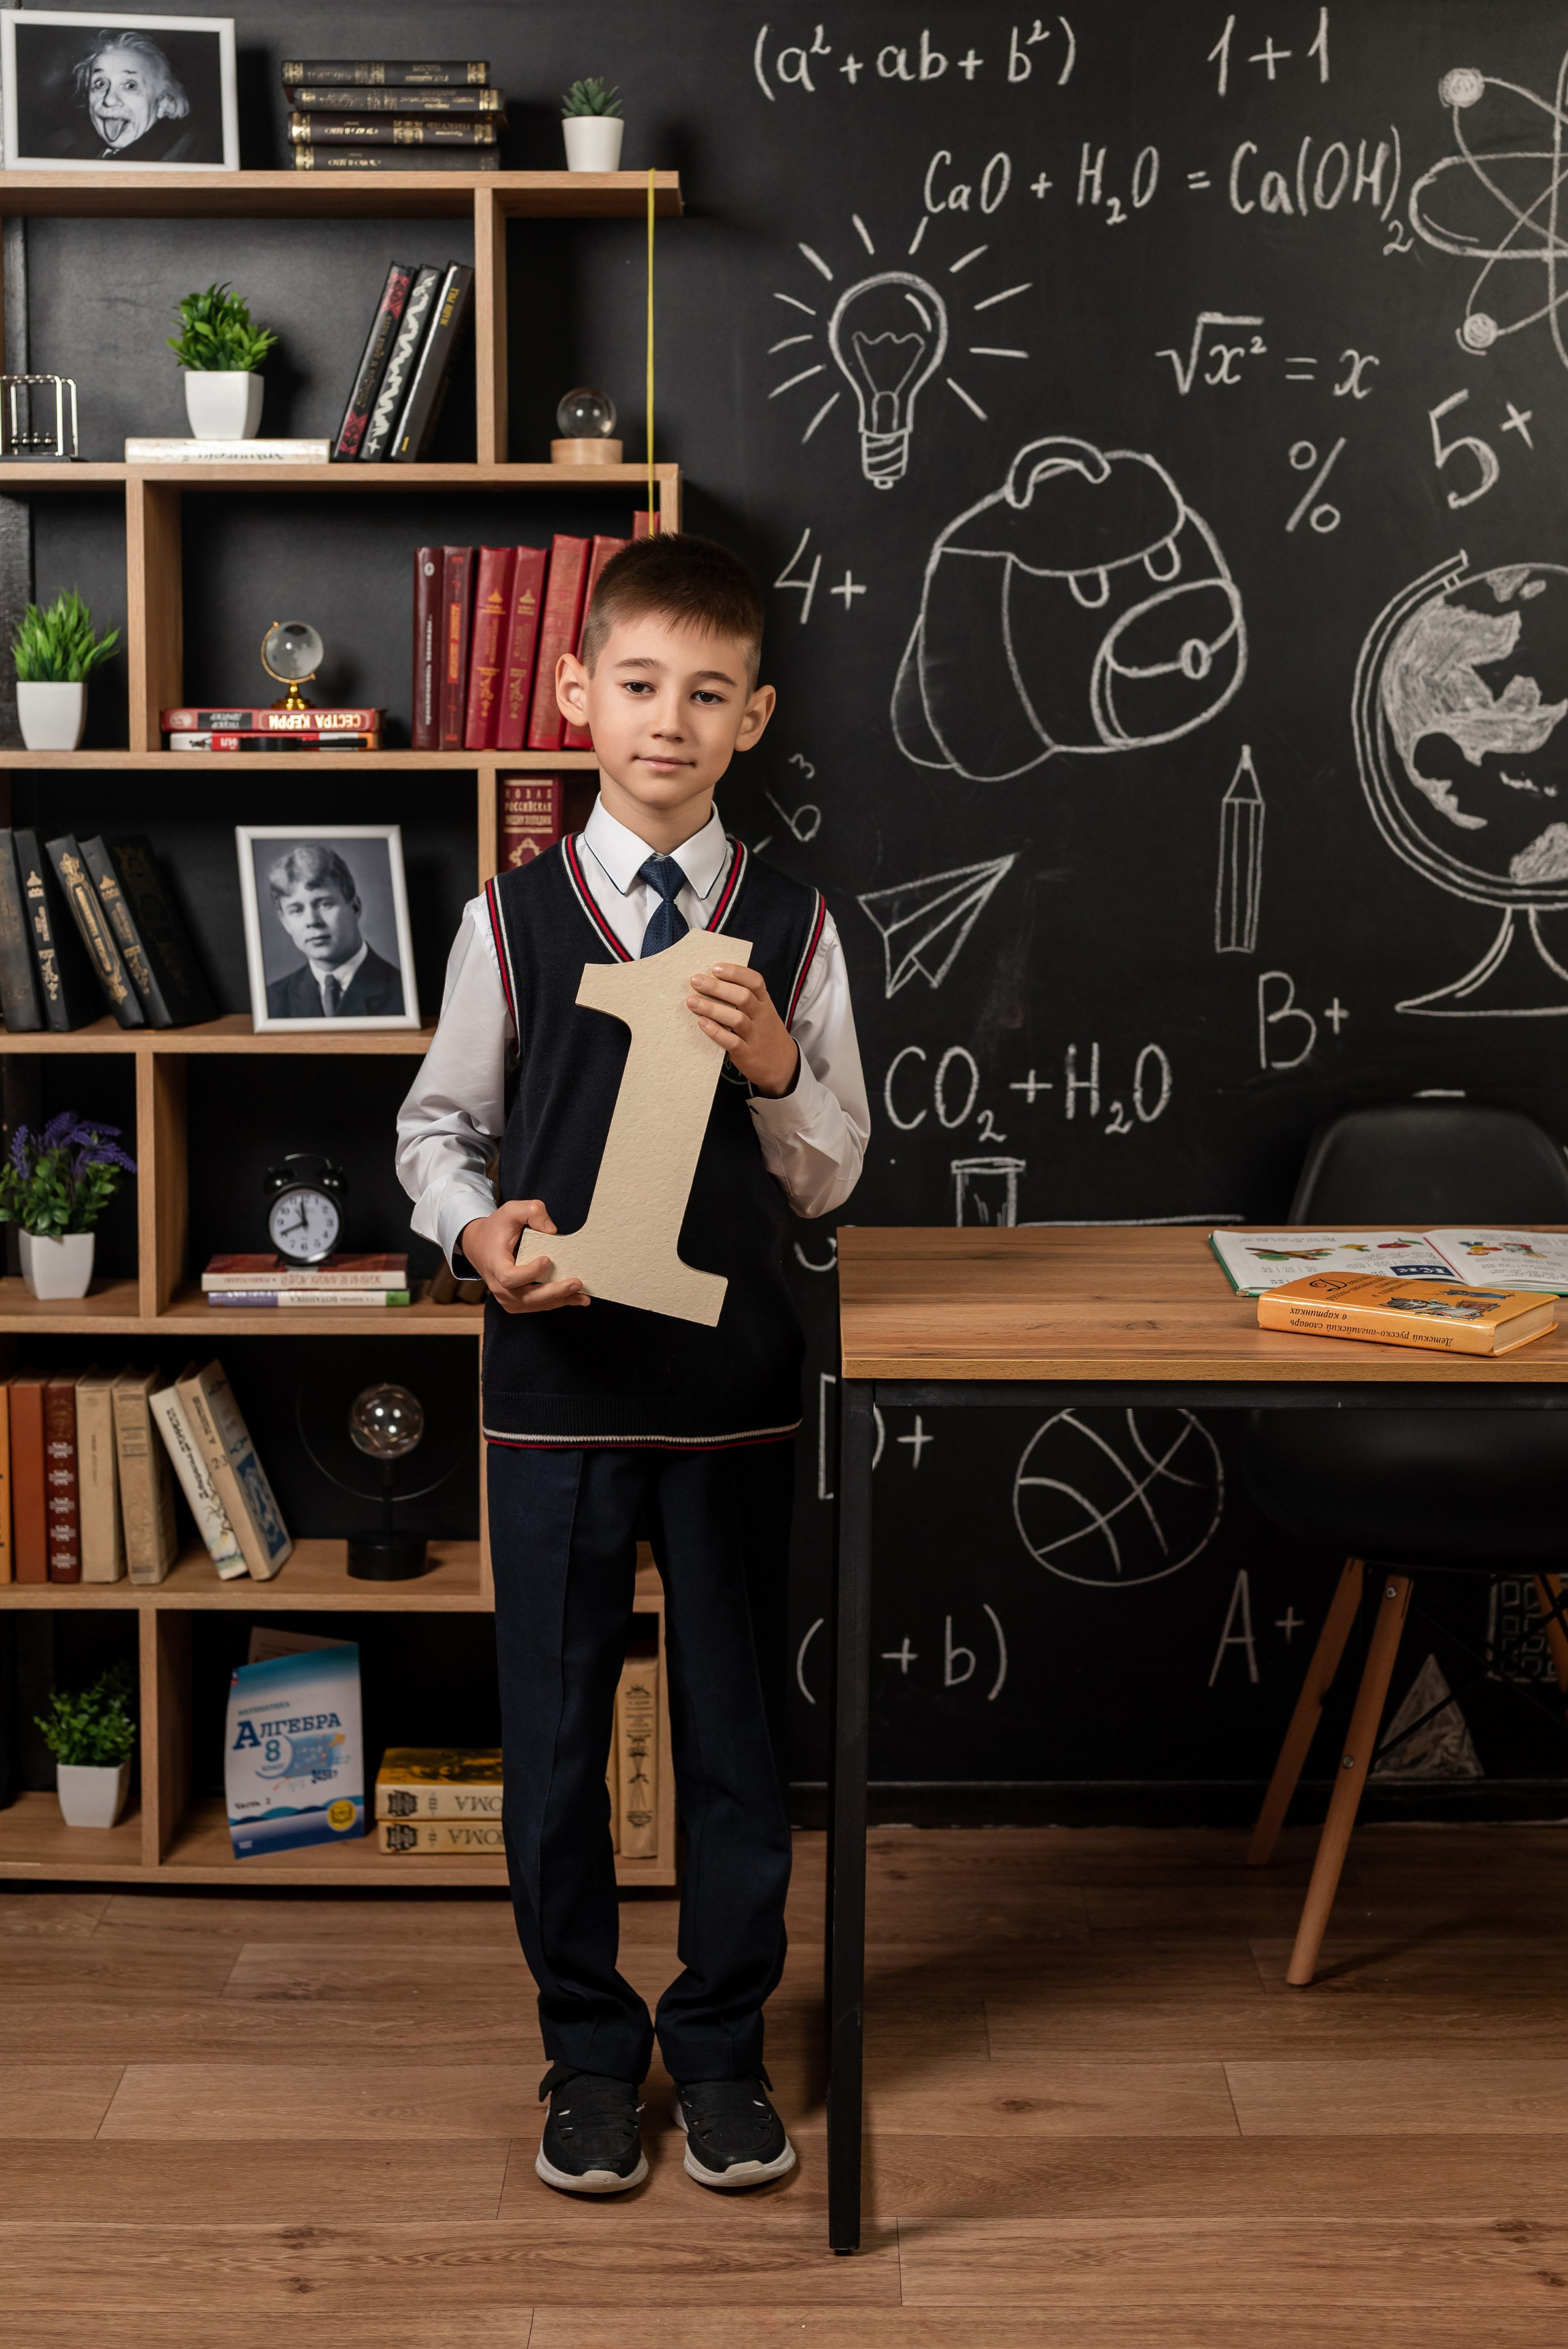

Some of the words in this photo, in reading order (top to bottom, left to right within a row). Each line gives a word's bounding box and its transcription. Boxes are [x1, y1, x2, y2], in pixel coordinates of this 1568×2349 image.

[1285, 436, 1347, 534] %
[268, 713, 311, 730] КЕРРИ
[314, 712, 361, 730] СЕСТРА
[1289, 1308, 1340, 1320] картинках
[1289, 1319, 1324, 1330] словарь
[1326, 1323, 1409, 1340] русско-английский
[1412, 1334, 1454, 1347] Детский
[265, 1739, 281, 1763] 8
